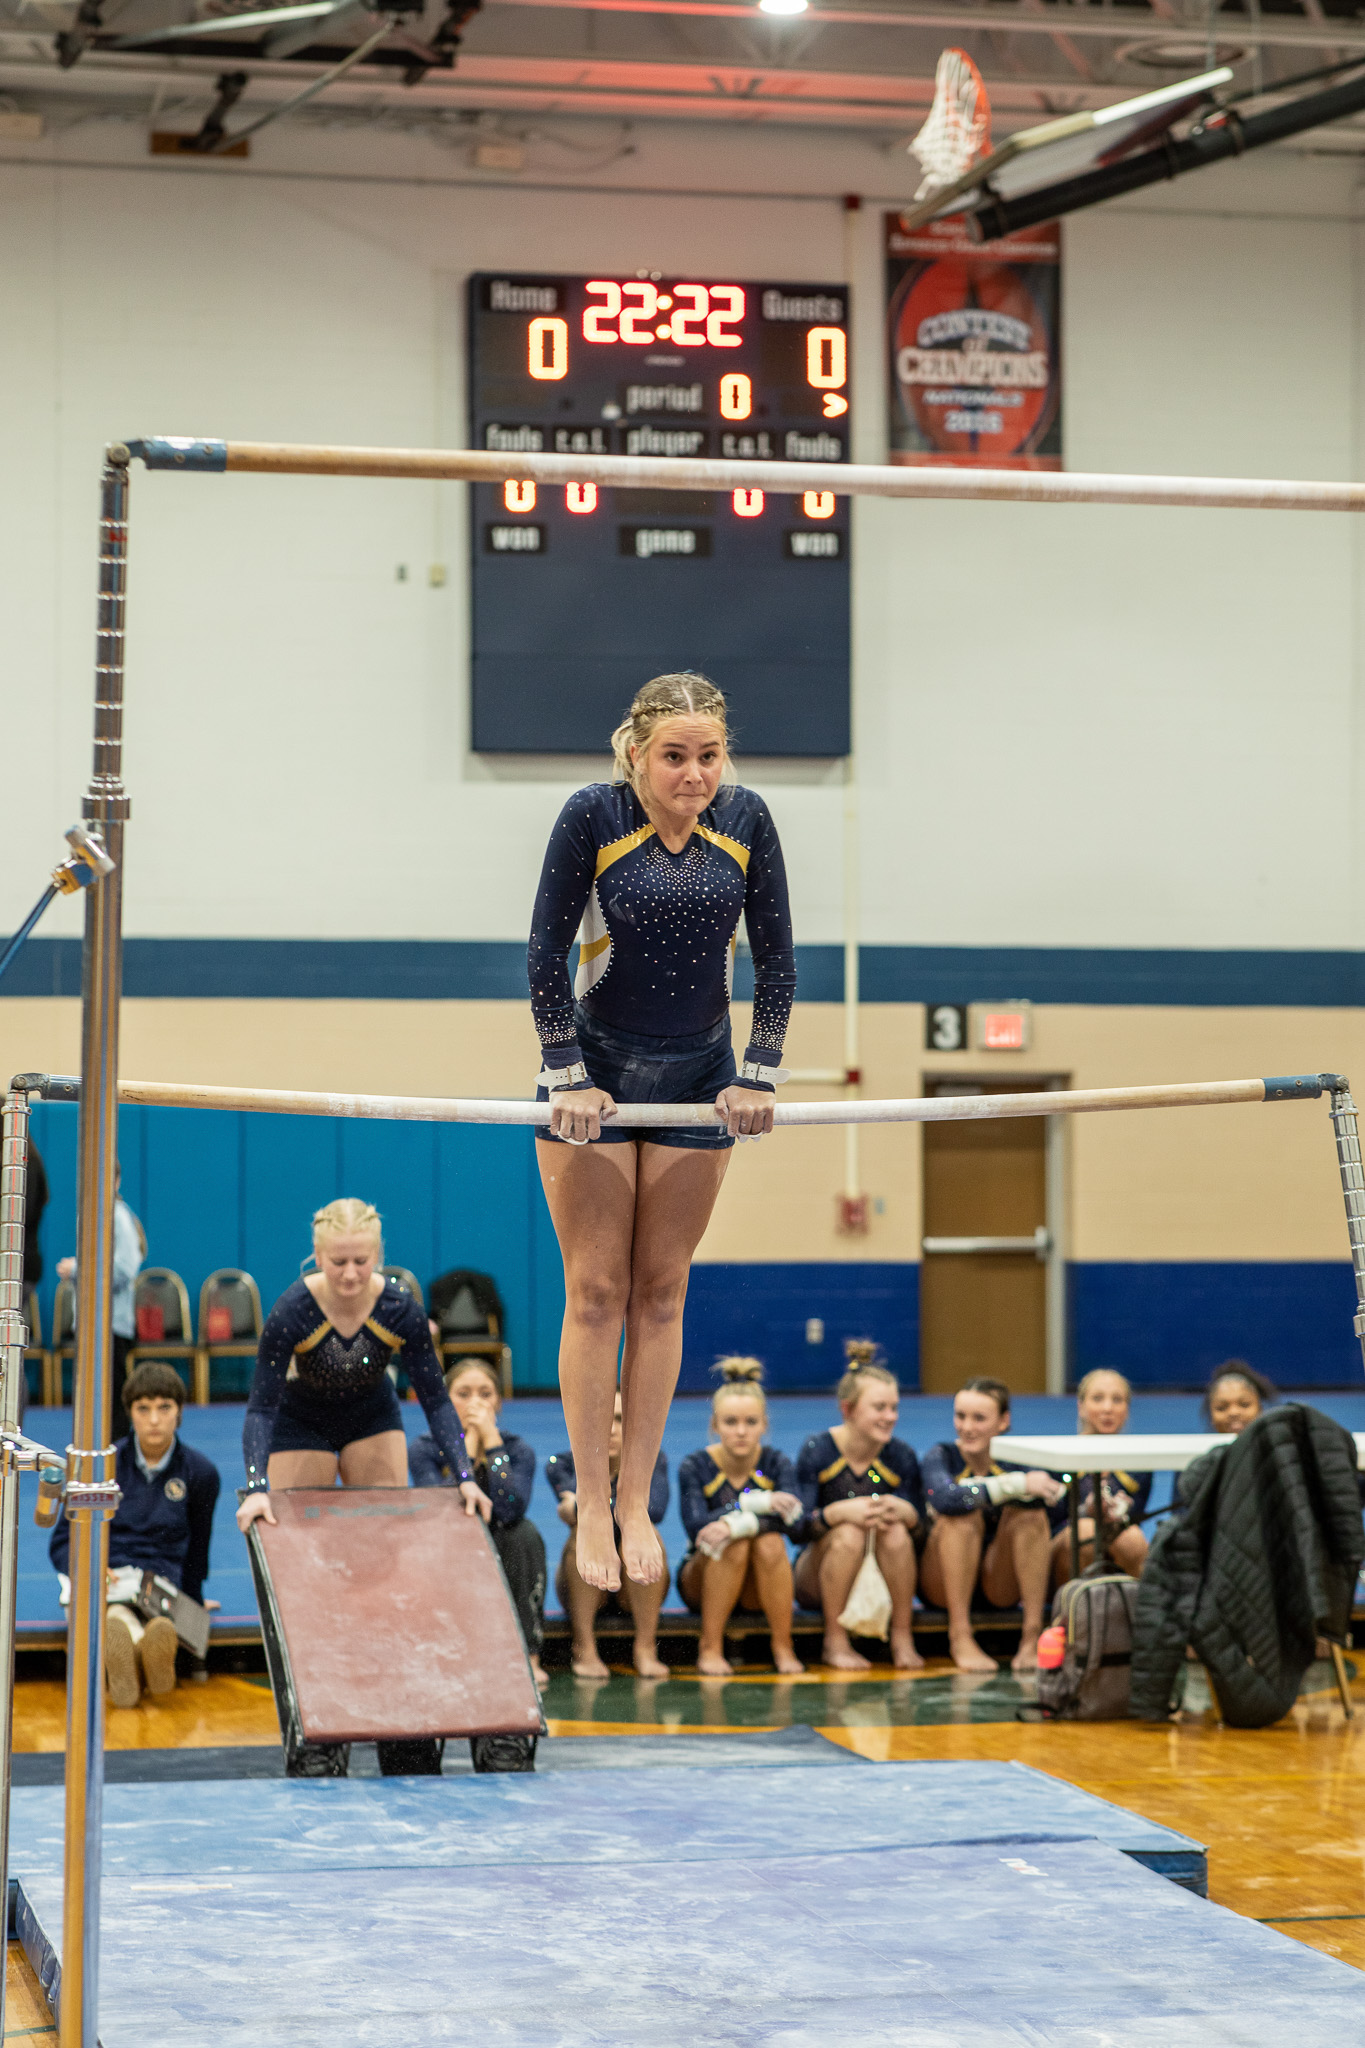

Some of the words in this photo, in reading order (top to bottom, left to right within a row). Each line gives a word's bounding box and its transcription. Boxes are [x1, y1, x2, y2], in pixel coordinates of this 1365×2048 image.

[490, 281, 557, 313] Home
[762, 290, 844, 322] Guests
[582, 281, 746, 347] 22:22
[528, 317, 568, 380] 0
[807, 327, 847, 389] 0
[897, 347, 1048, 388] CHAMPIONS
[627, 384, 703, 414] period
[719, 373, 752, 420] 0
[627, 425, 704, 457] player
[491, 526, 541, 551] won
[636, 529, 696, 558] game
[790, 532, 839, 557] won
[933, 1006, 961, 1049] 3
